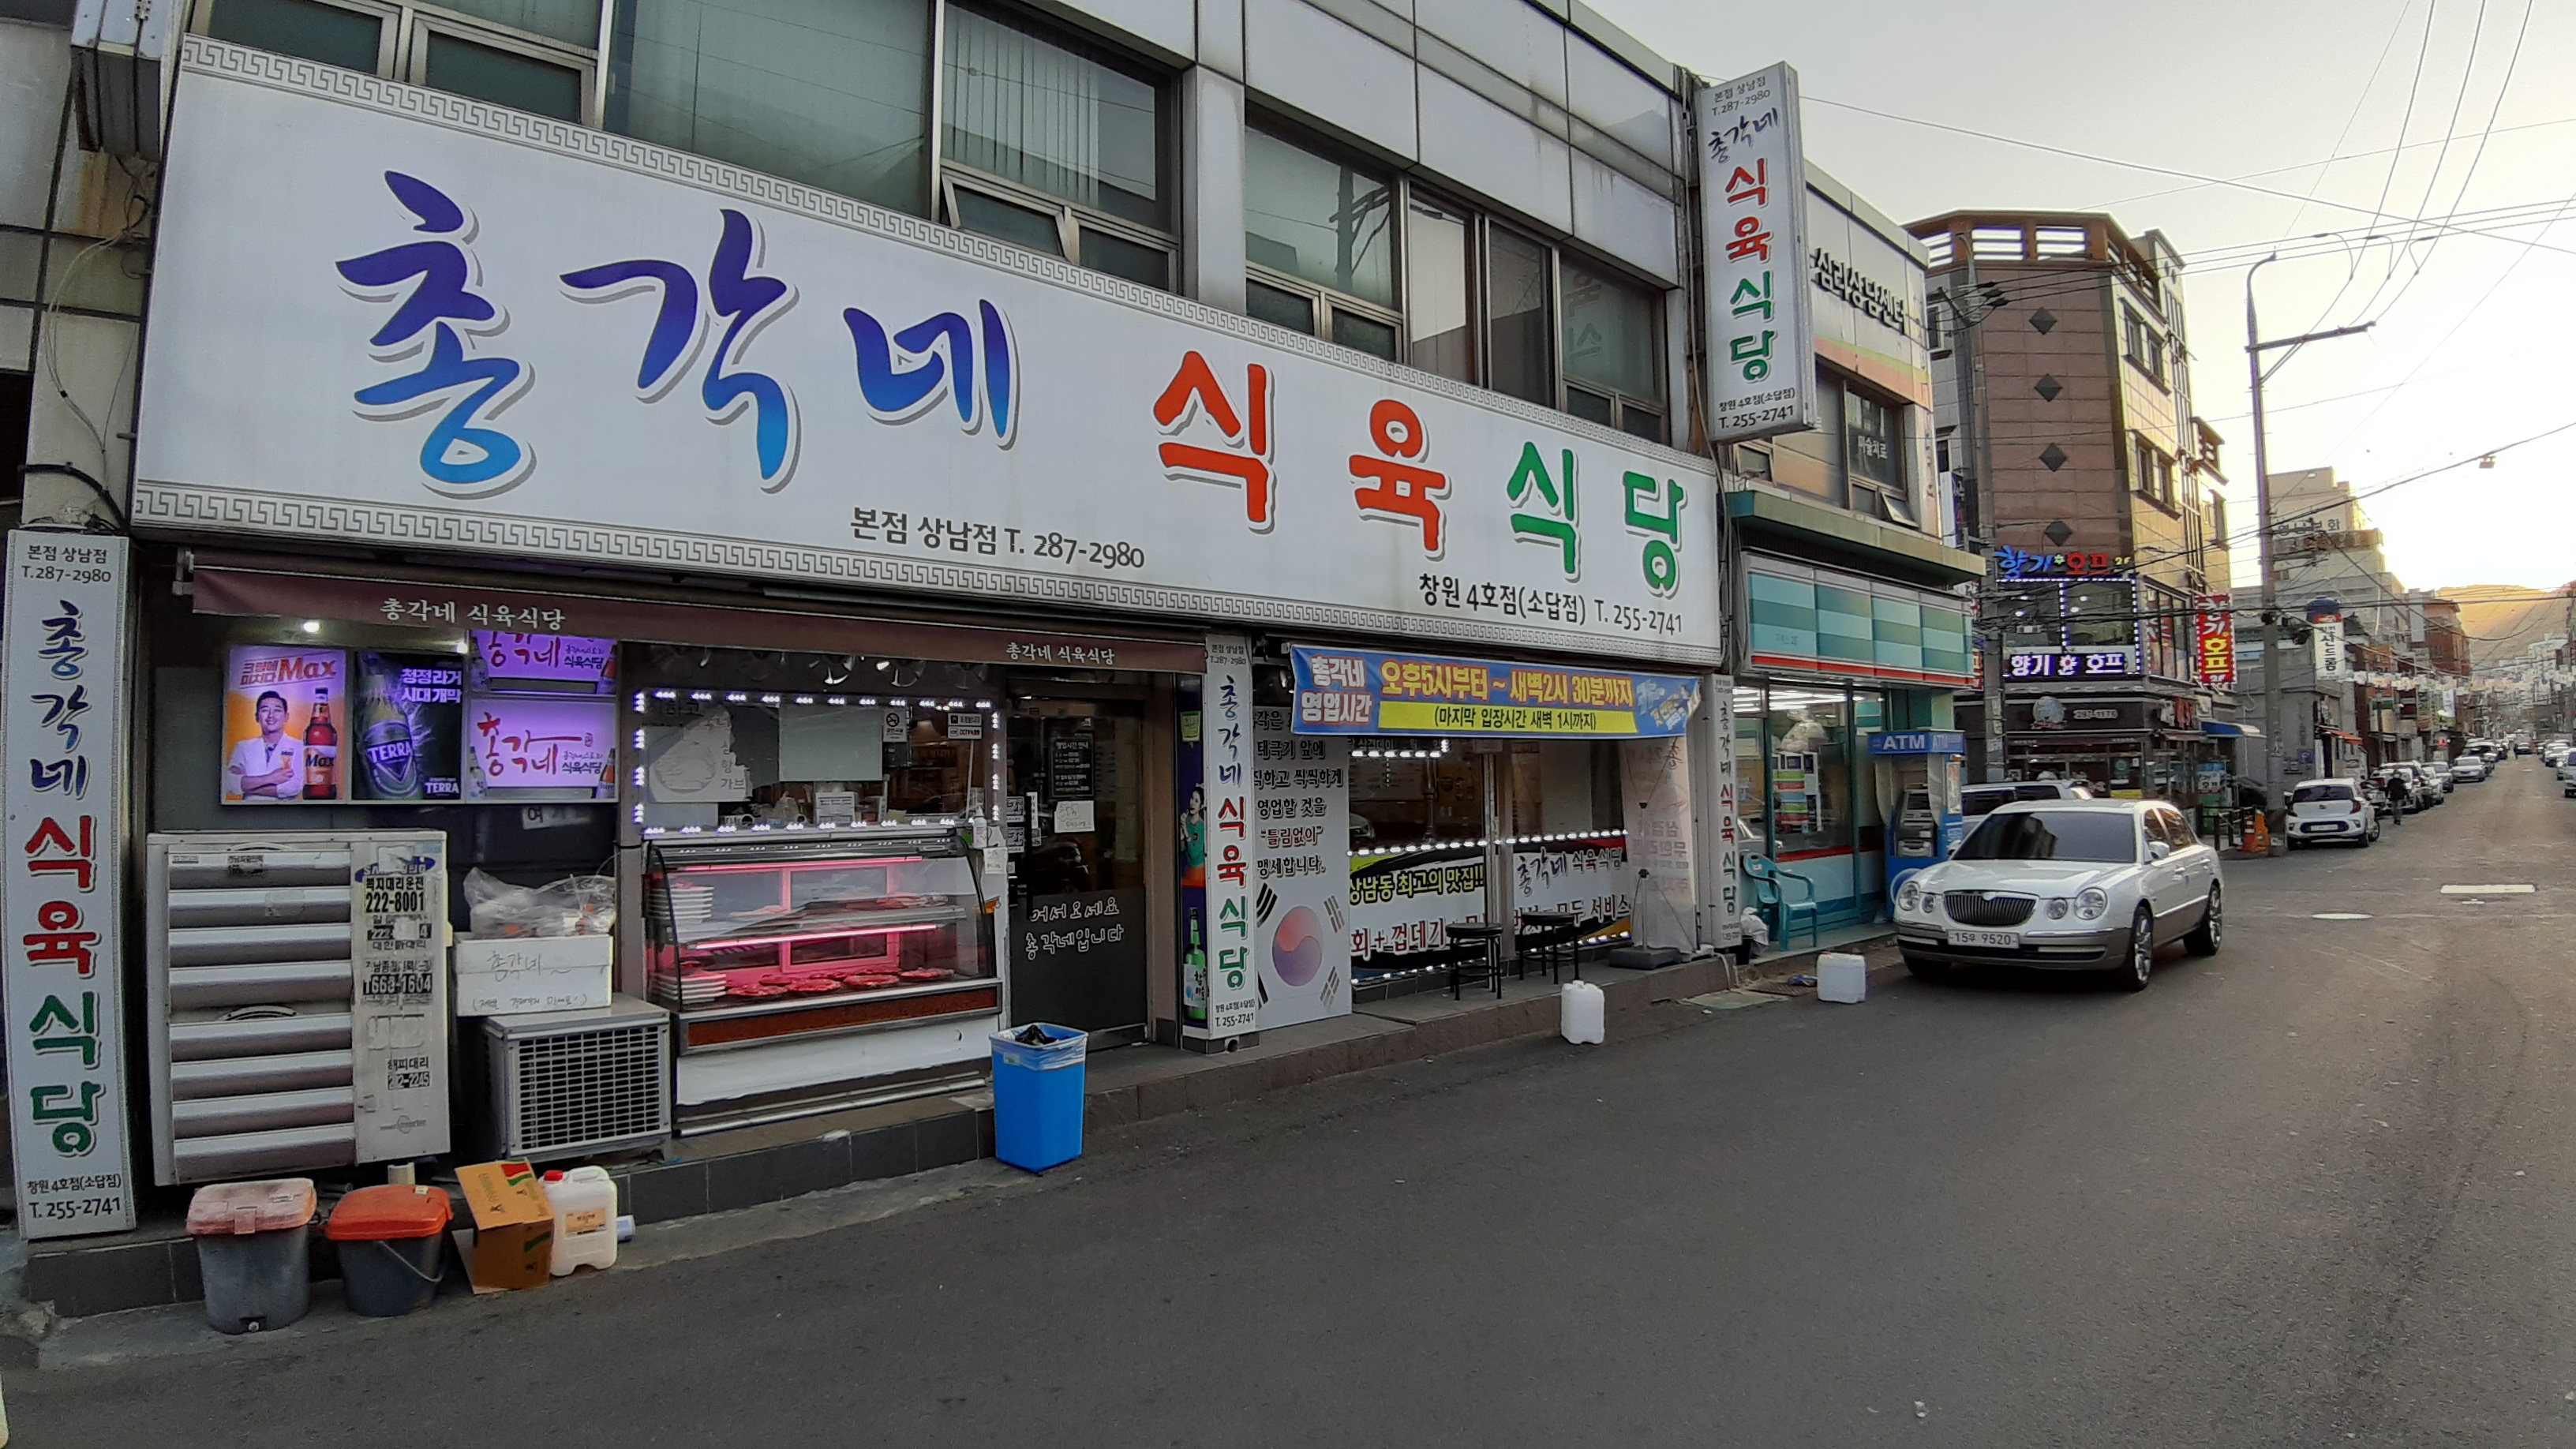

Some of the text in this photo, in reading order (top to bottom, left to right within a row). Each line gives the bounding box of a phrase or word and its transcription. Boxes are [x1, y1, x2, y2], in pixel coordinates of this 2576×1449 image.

[1714, 76, 1768, 104] 본점 상남점
[1708, 107, 1779, 164] 총각네
[1724, 159, 1774, 381] 식육식당
[1812, 247, 1909, 335] 심리상담센터
[335, 170, 1017, 494] 총각네
[1719, 399, 1736, 412] 창원
[1732, 406, 1794, 428] 255-2741
[1151, 350, 1687, 597] 식육식당
[850, 506, 1146, 570] 본점 상남점 T. 287-2980
[27, 545, 107, 565] 본점 상남점
[1994, 545, 2054, 578] 향기
[21, 565, 112, 583] T.287-2980
[380, 597, 567, 631] 총각네 식육식당
[1419, 573, 1683, 636] 창원 4호점(소답점) T. 255-2741
[564, 655, 605, 669] 식육식당
[1005, 642, 1115, 665] 총각네 식육식당
[2011, 653, 2123, 676] 향기 호프
[2203, 638, 2230, 672] 호프
[278, 657, 338, 683] Max
[1310, 656, 1366, 688] 총각네
[1380, 661, 1488, 701] 오후5시부터
[1510, 668, 1568, 706] 새벽2시
[1571, 675, 1634, 709] 30분까지
[29, 600, 89, 799] 총각네
[1301, 691, 1372, 724] 영업시간
[1218, 675, 1242, 788] 총각네
[1253, 710, 1282, 729] 각은
[1434, 703, 1597, 731] (마지막 입장시간 새벽 1시까지)
[368, 740, 414, 764] TERRA
[477, 712, 582, 776] 총각네
[1257, 739, 1325, 759] 태극기 앞에
[1882, 734, 1925, 751] ATM
[562, 761, 603, 775] 식육식당
[425, 781, 459, 794] TERRA
[1257, 796, 1327, 818] 영업할 것을
[1720, 782, 1735, 915] 식육식당
[1257, 855, 1326, 878] 맹세합니다.
[1517, 847, 1567, 897] 총각네
[1571, 848, 1623, 872] 식육식당
[1217, 796, 1247, 990] 식육식당
[1350, 874, 1395, 904] 상남동
[1396, 868, 1443, 897] 최고의
[366, 891, 425, 913] 222-8001
[1391, 917, 1446, 955] 껍데기
[1982, 934, 2011, 945] 9520
[487, 950, 541, 982] 총각네
[24, 816, 104, 1155] 식육식당
[1222, 1013, 1254, 1028] 255-2741
[28, 1178, 50, 1193] 창원
[47, 1196, 122, 1220] 255-2741
